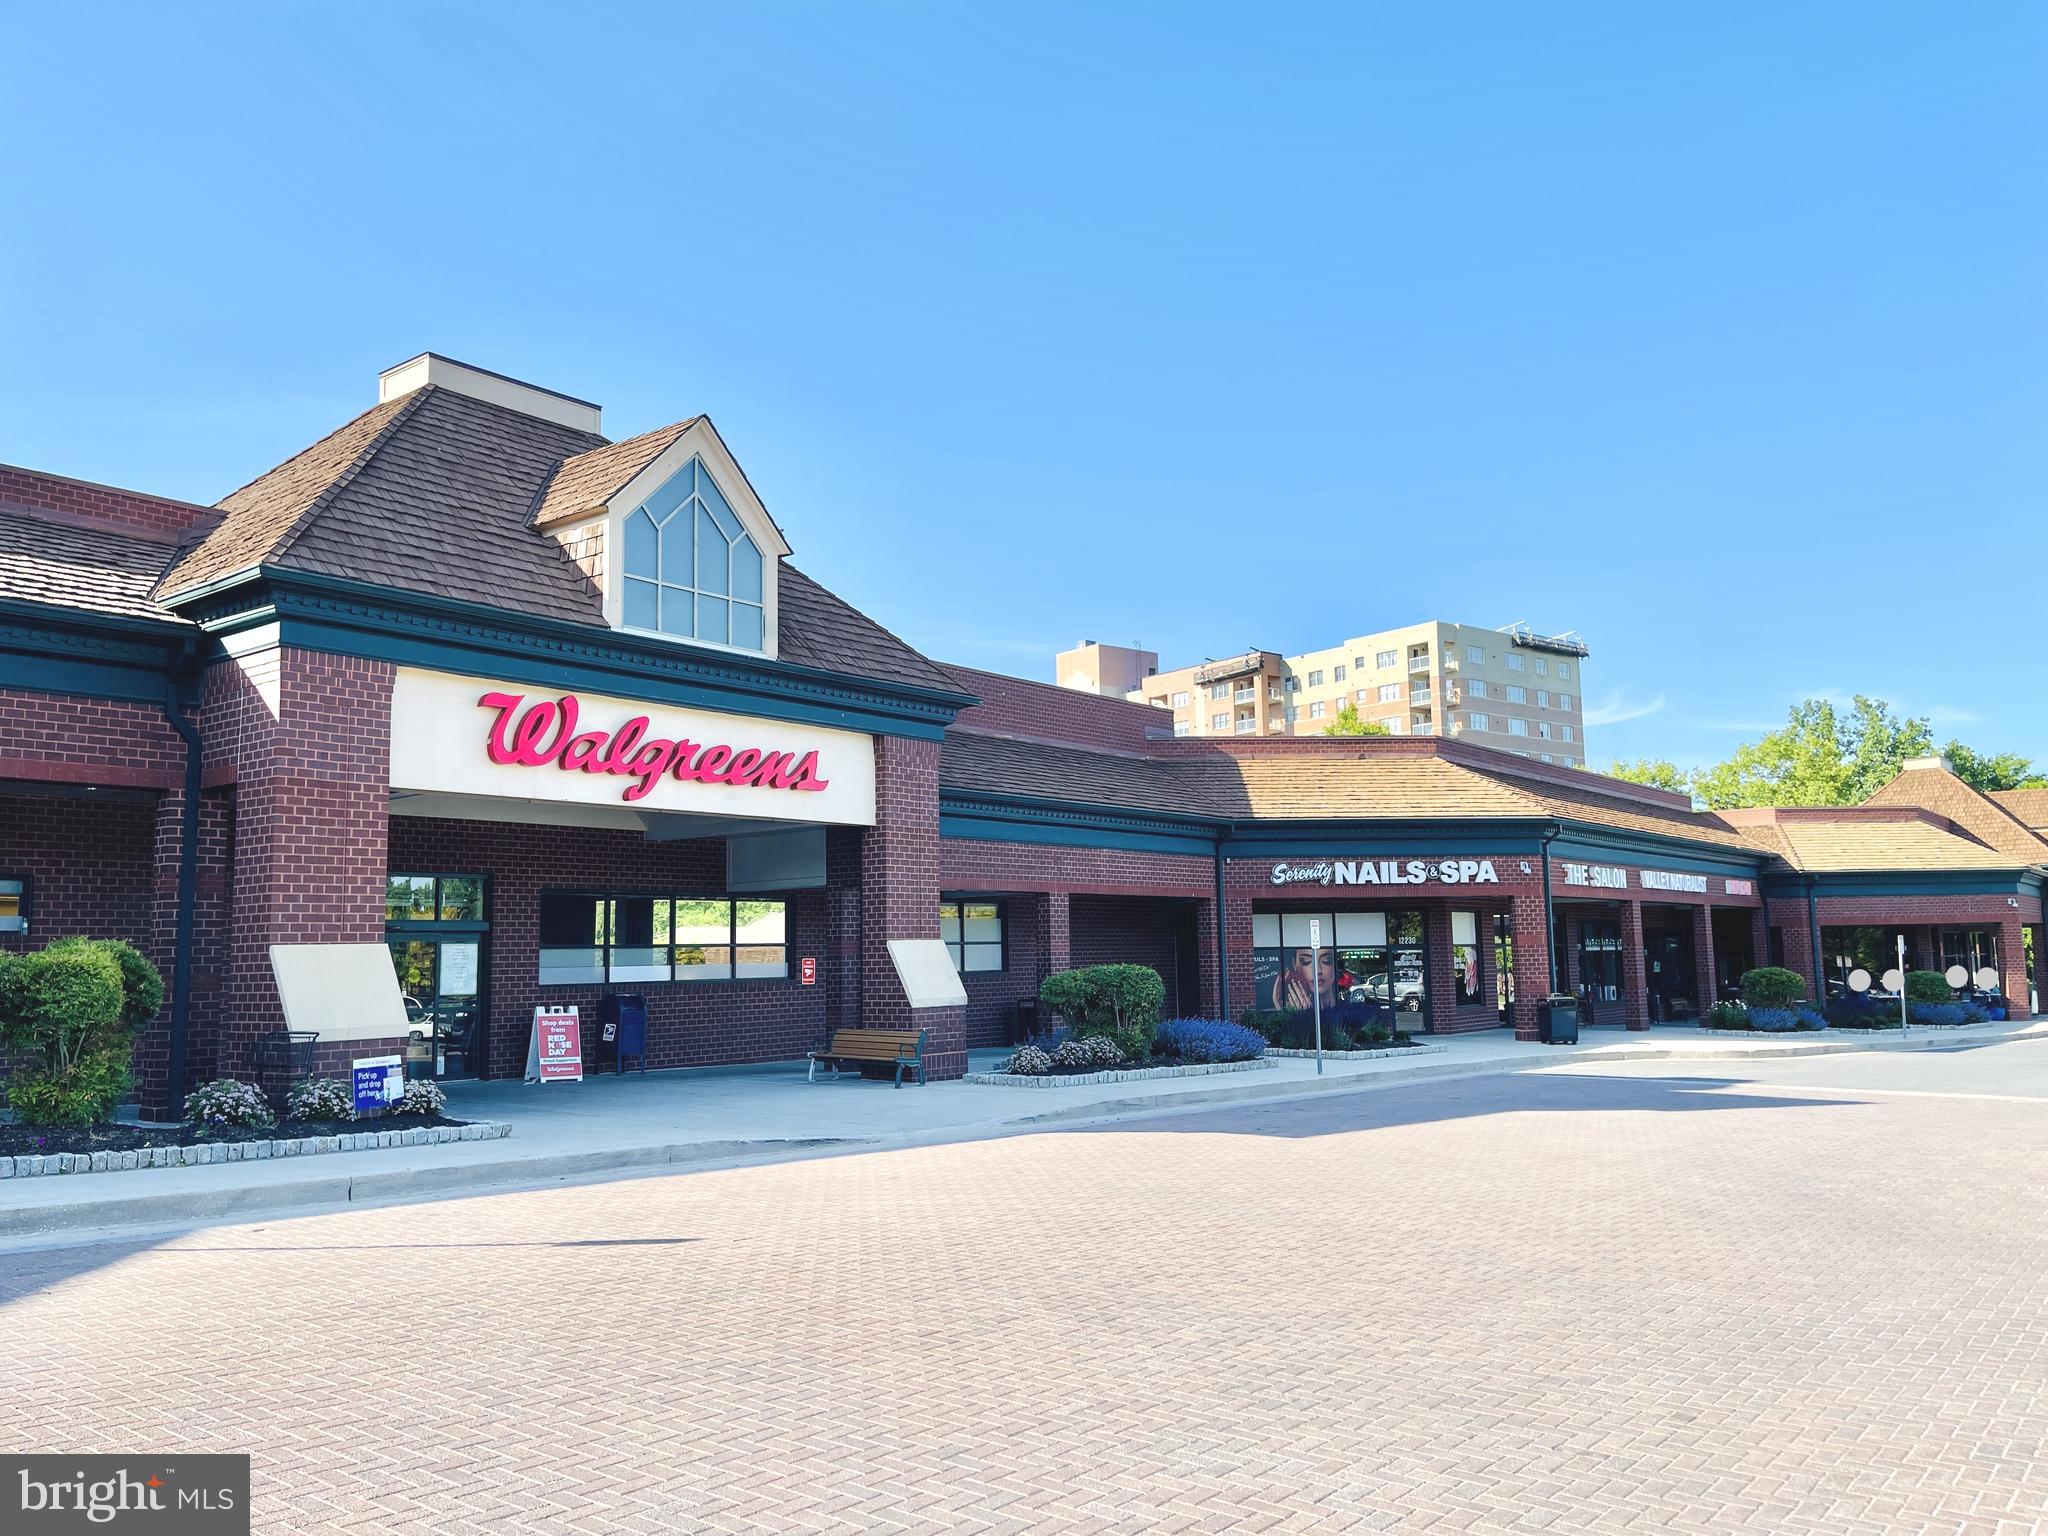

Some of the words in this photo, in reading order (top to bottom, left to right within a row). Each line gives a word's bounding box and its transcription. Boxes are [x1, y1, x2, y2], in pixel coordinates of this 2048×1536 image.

[477, 692, 829, 801] Walgreens
[1272, 862, 1333, 886] Serenity
[1335, 861, 1427, 885] NAILS
[1426, 864, 1440, 879] &
[1440, 861, 1500, 884] SPA
[1562, 864, 1590, 885] THE
[1589, 866, 1628, 889] SALON
[1640, 870, 1669, 891] VALLEY
[358, 1081, 369, 1090] and
[369, 1080, 382, 1089] drop
[358, 1090, 367, 1099] off
